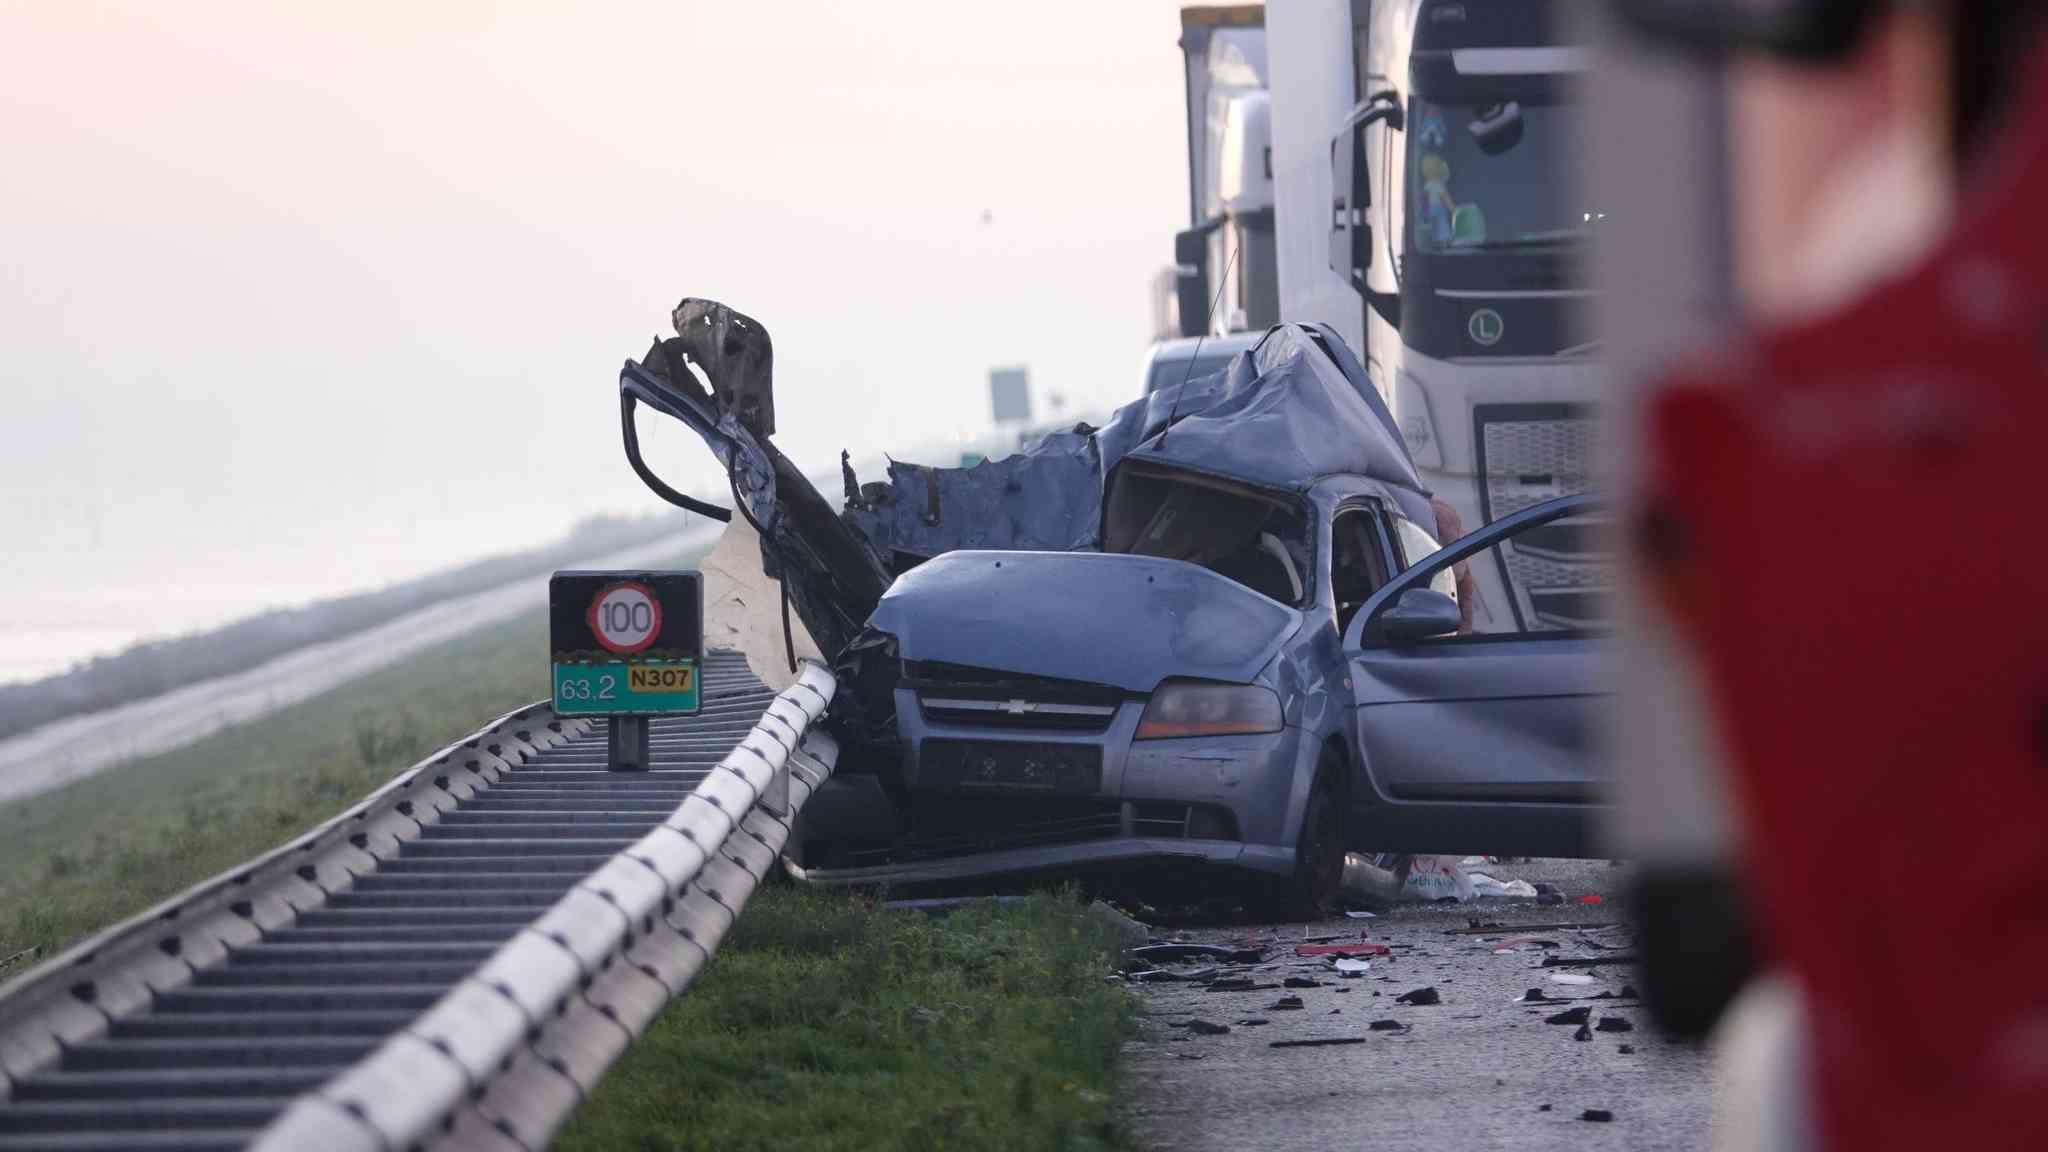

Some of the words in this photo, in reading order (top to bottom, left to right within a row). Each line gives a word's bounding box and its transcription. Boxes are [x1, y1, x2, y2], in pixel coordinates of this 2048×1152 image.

[1480, 317, 1495, 337] L
[603, 601, 652, 633] 100
[561, 675, 616, 701] 63,2
[631, 669, 689, 688] N307
